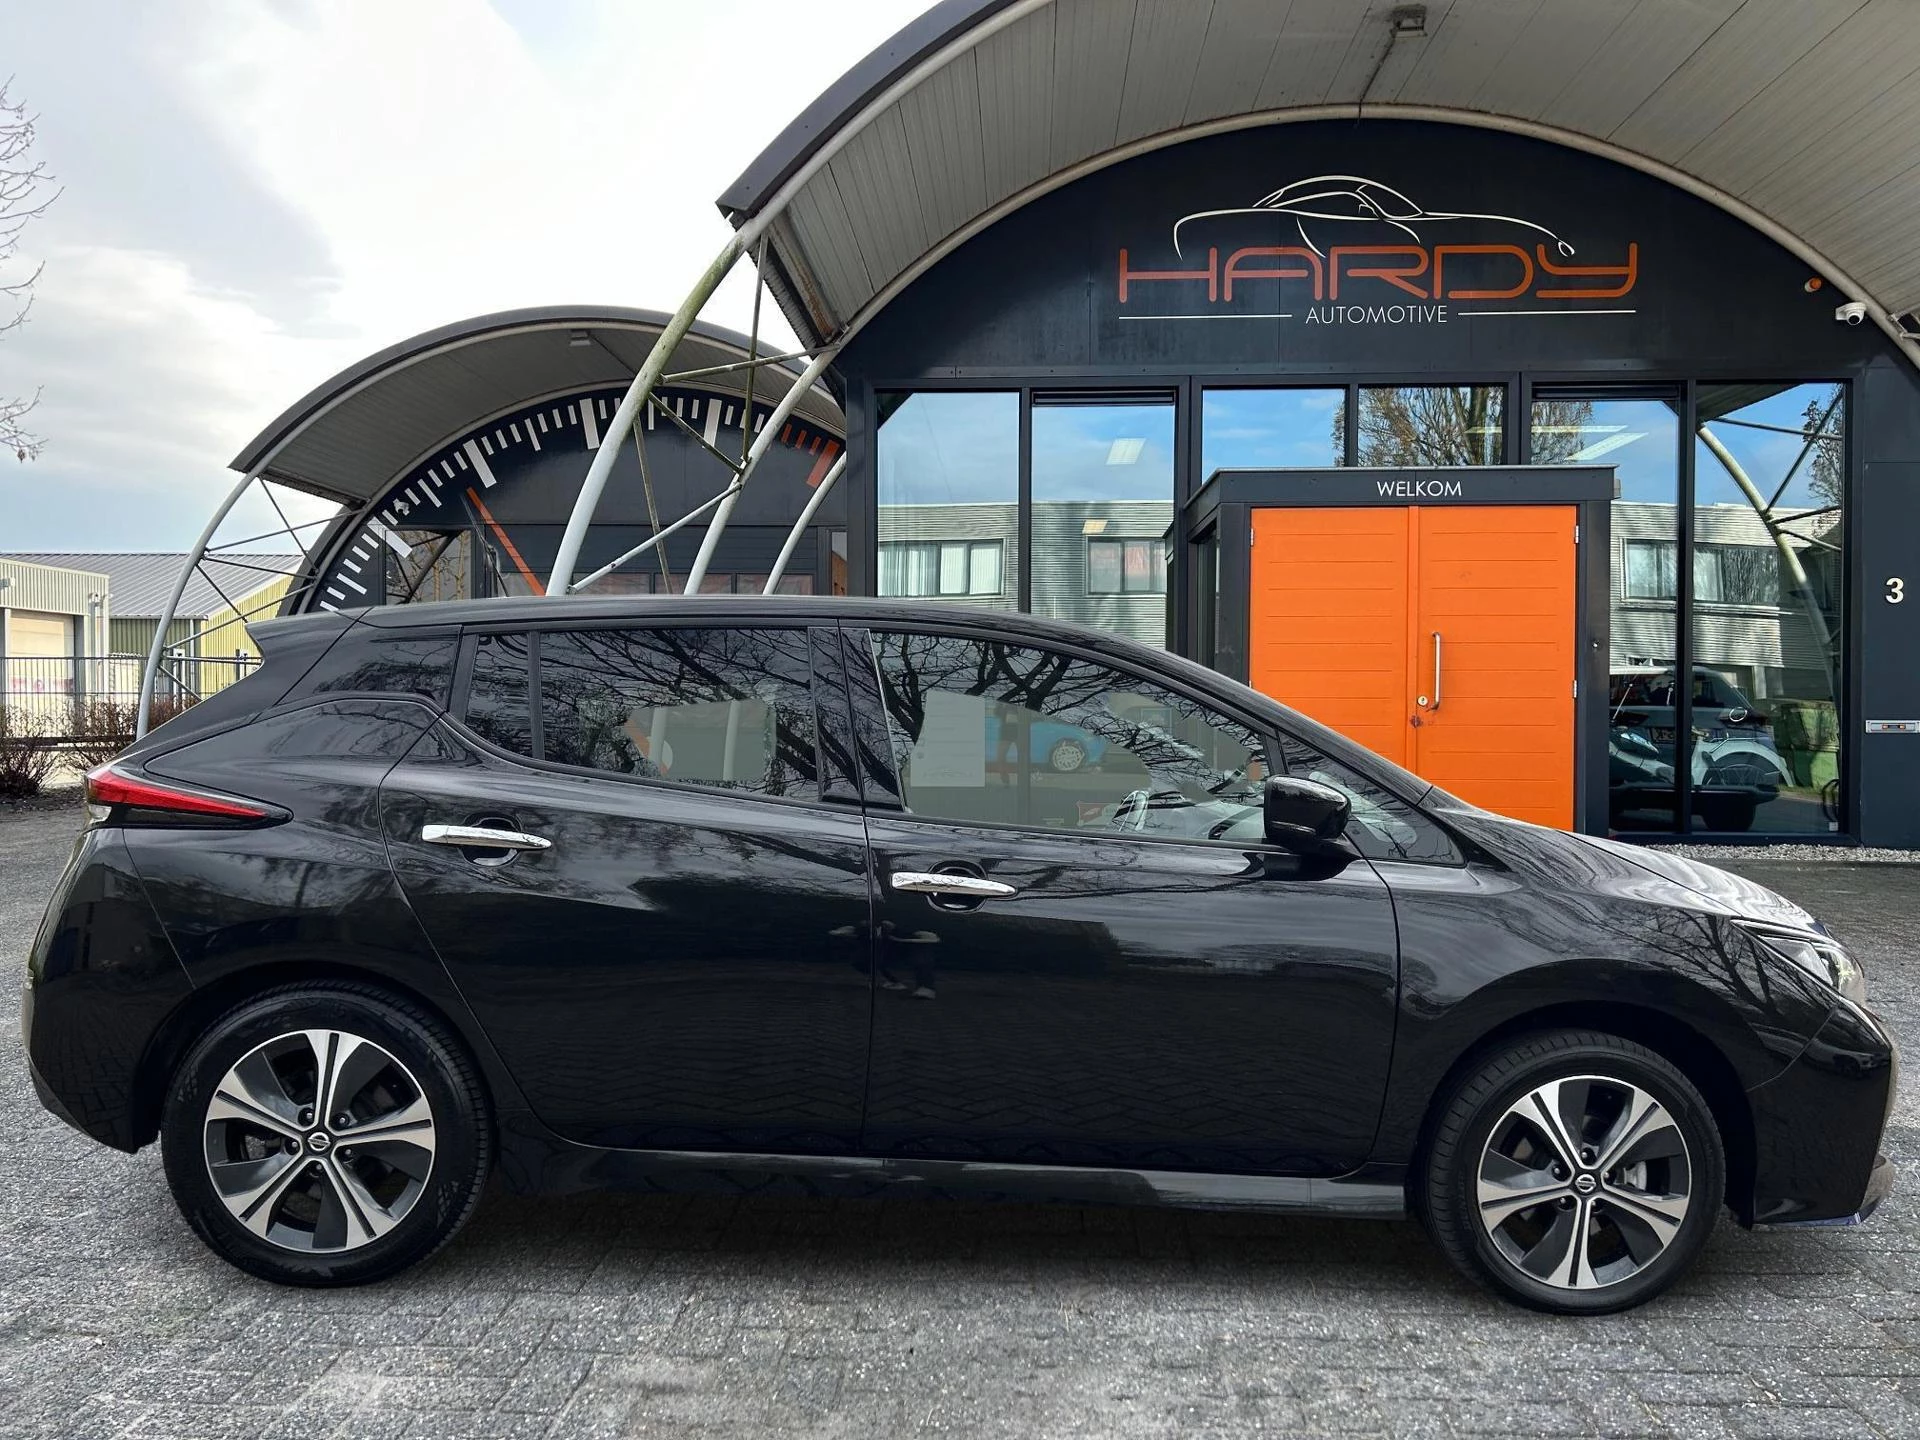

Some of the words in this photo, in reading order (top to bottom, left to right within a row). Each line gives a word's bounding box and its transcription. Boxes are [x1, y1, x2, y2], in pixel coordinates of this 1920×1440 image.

[1119, 242, 1638, 303] HARDY
[1306, 306, 1447, 323] AUTOMOTIVE
[1377, 481, 1461, 496] WELKOM
[1886, 578, 1903, 603] 3
